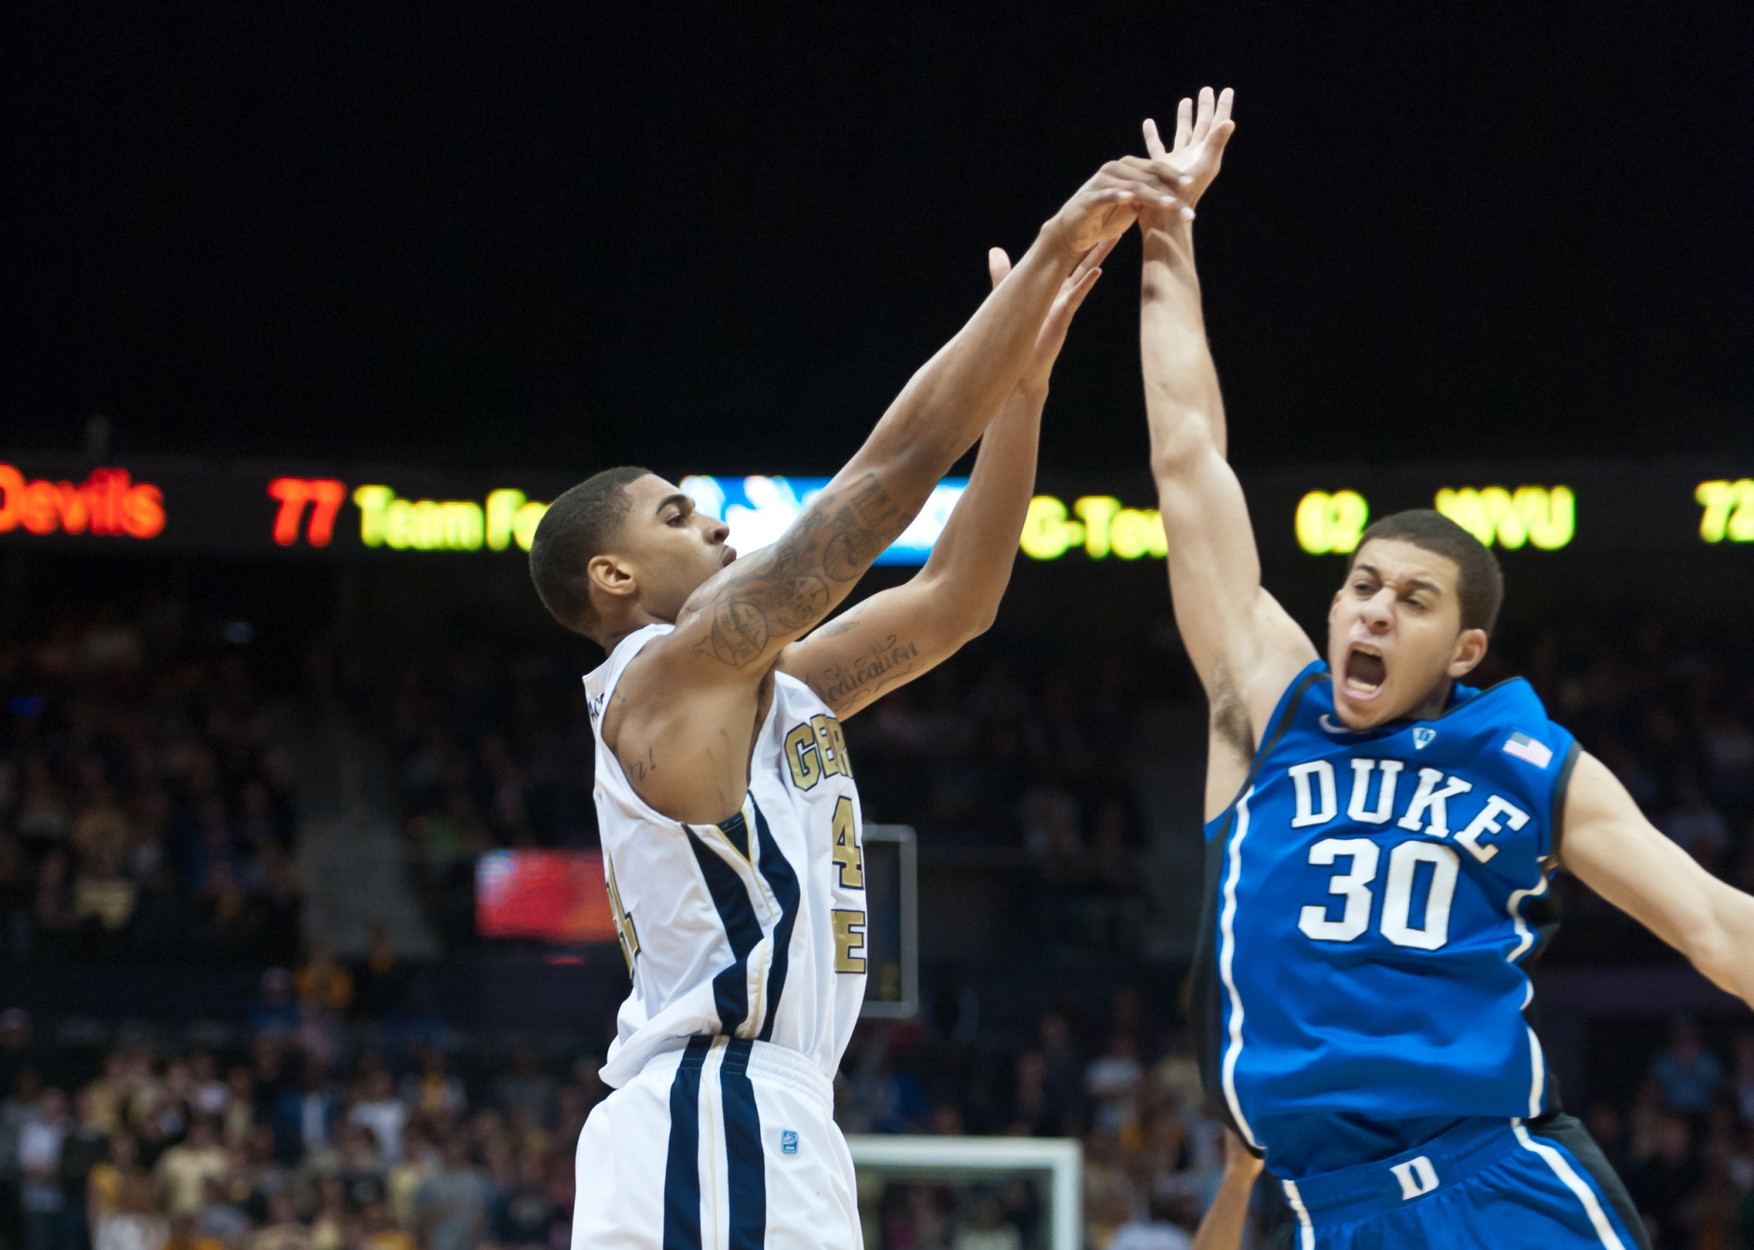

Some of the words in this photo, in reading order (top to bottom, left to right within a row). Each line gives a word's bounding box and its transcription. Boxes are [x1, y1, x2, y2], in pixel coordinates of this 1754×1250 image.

[267, 476, 347, 546] 77
[353, 484, 485, 549] Team
[1288, 758, 1531, 864] DUKE
[1298, 838, 1461, 951] 30
[1389, 1156, 1440, 1201] D
